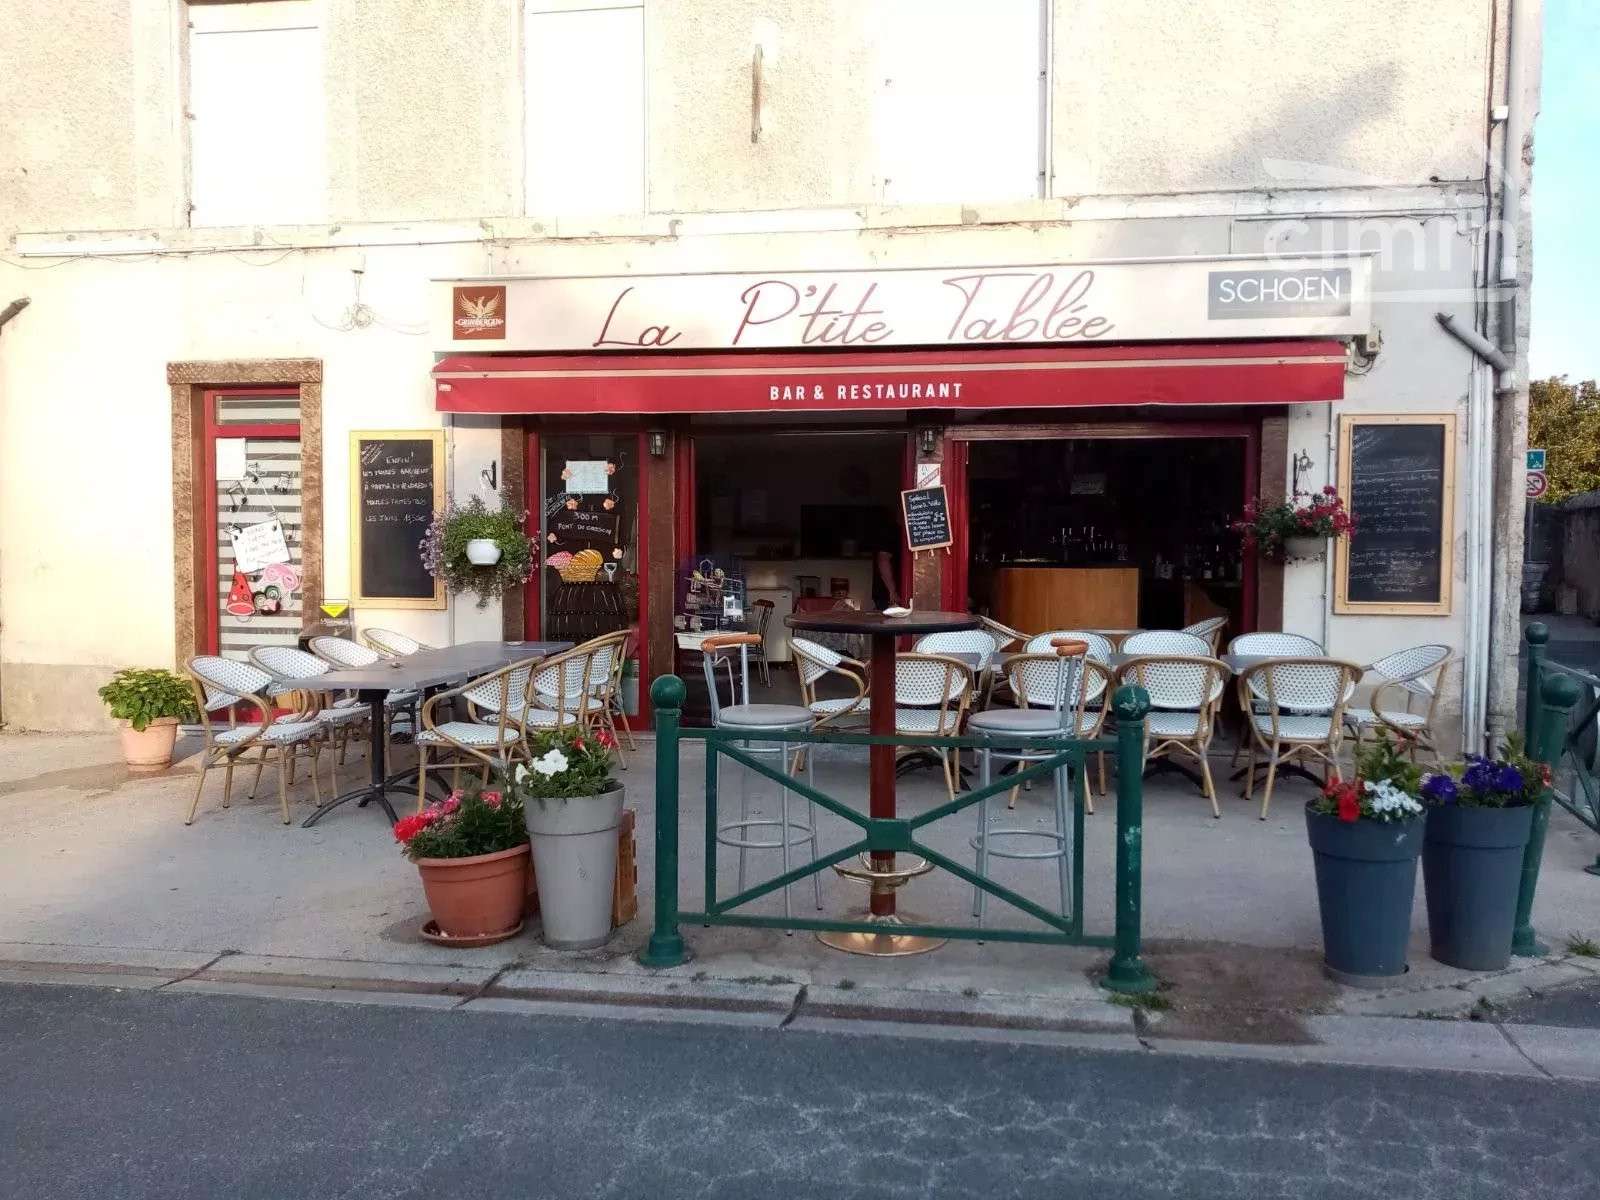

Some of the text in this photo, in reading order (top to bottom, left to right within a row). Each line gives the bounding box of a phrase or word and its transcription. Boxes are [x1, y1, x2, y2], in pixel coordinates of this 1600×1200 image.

[1218, 276, 1342, 304] SCHOEN
[592, 270, 1115, 348] La P'tite Tablée
[769, 382, 964, 402] BAR & RESTAURANT
